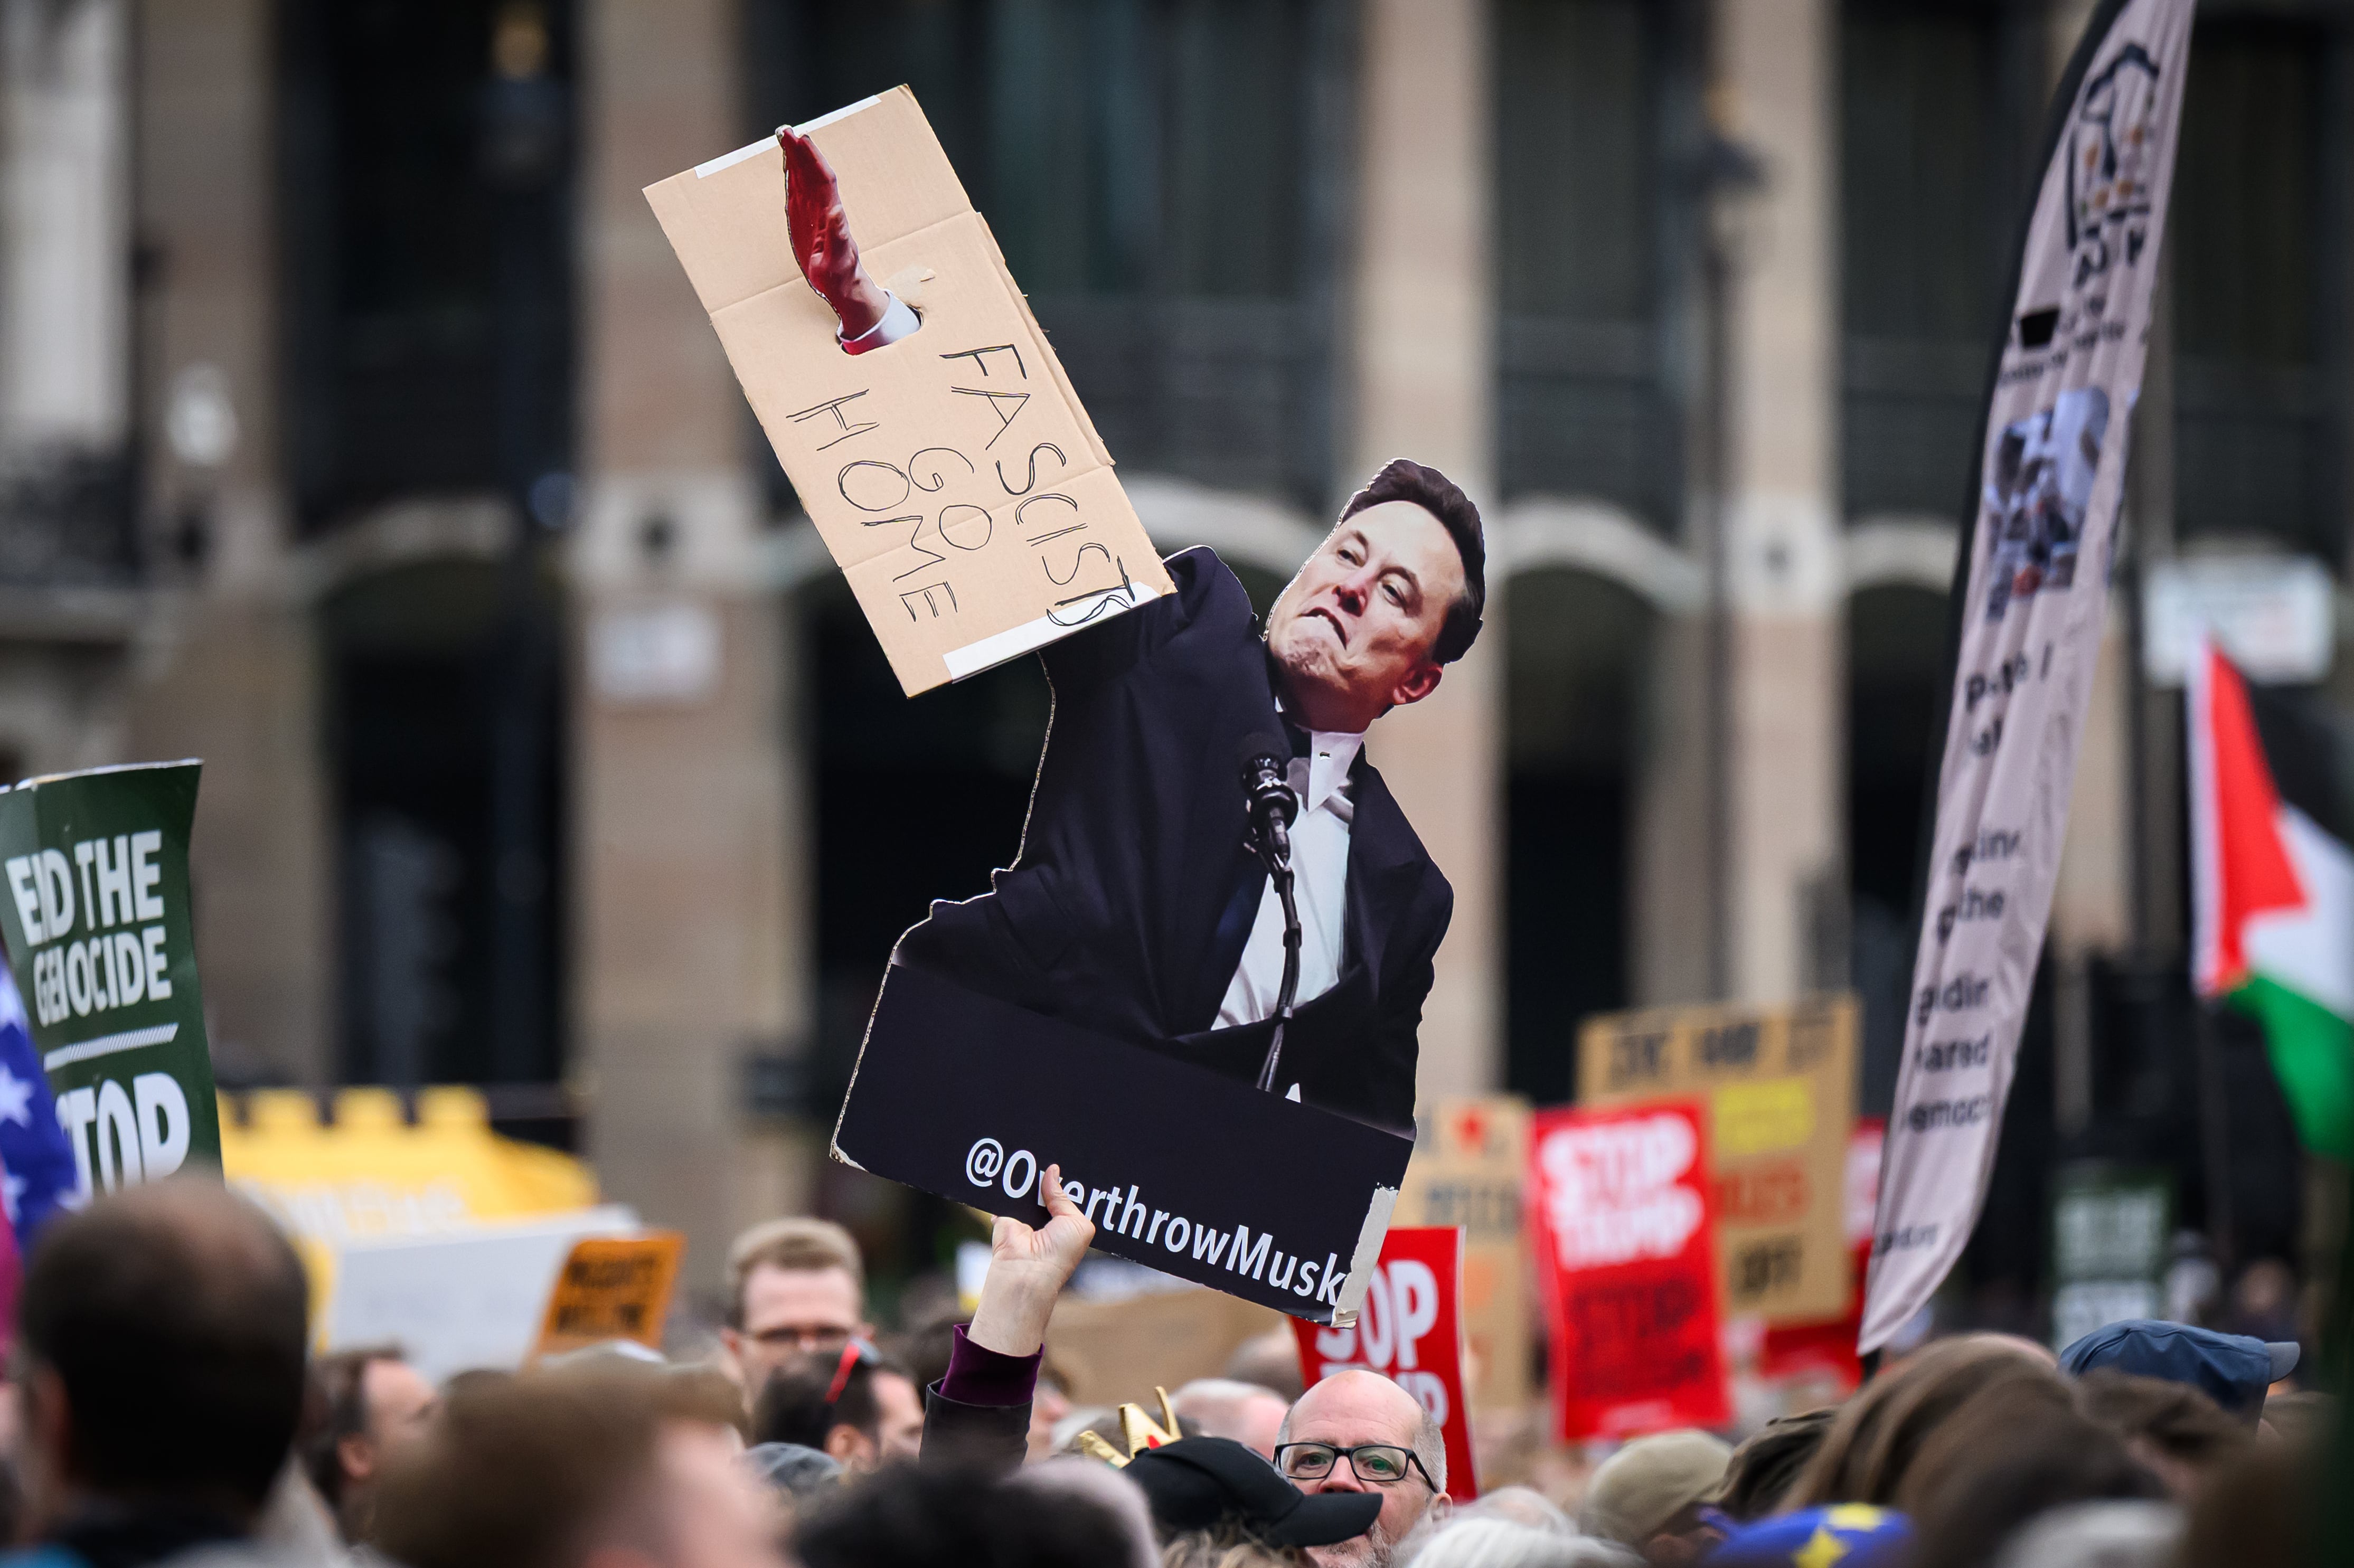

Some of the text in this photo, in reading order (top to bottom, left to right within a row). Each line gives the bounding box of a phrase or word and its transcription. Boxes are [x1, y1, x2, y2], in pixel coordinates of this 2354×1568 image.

[786, 389, 958, 622] HOME
[908, 447, 992, 550] GO
[74, 829, 165, 931] THE
[55, 1071, 191, 1205] TOP
